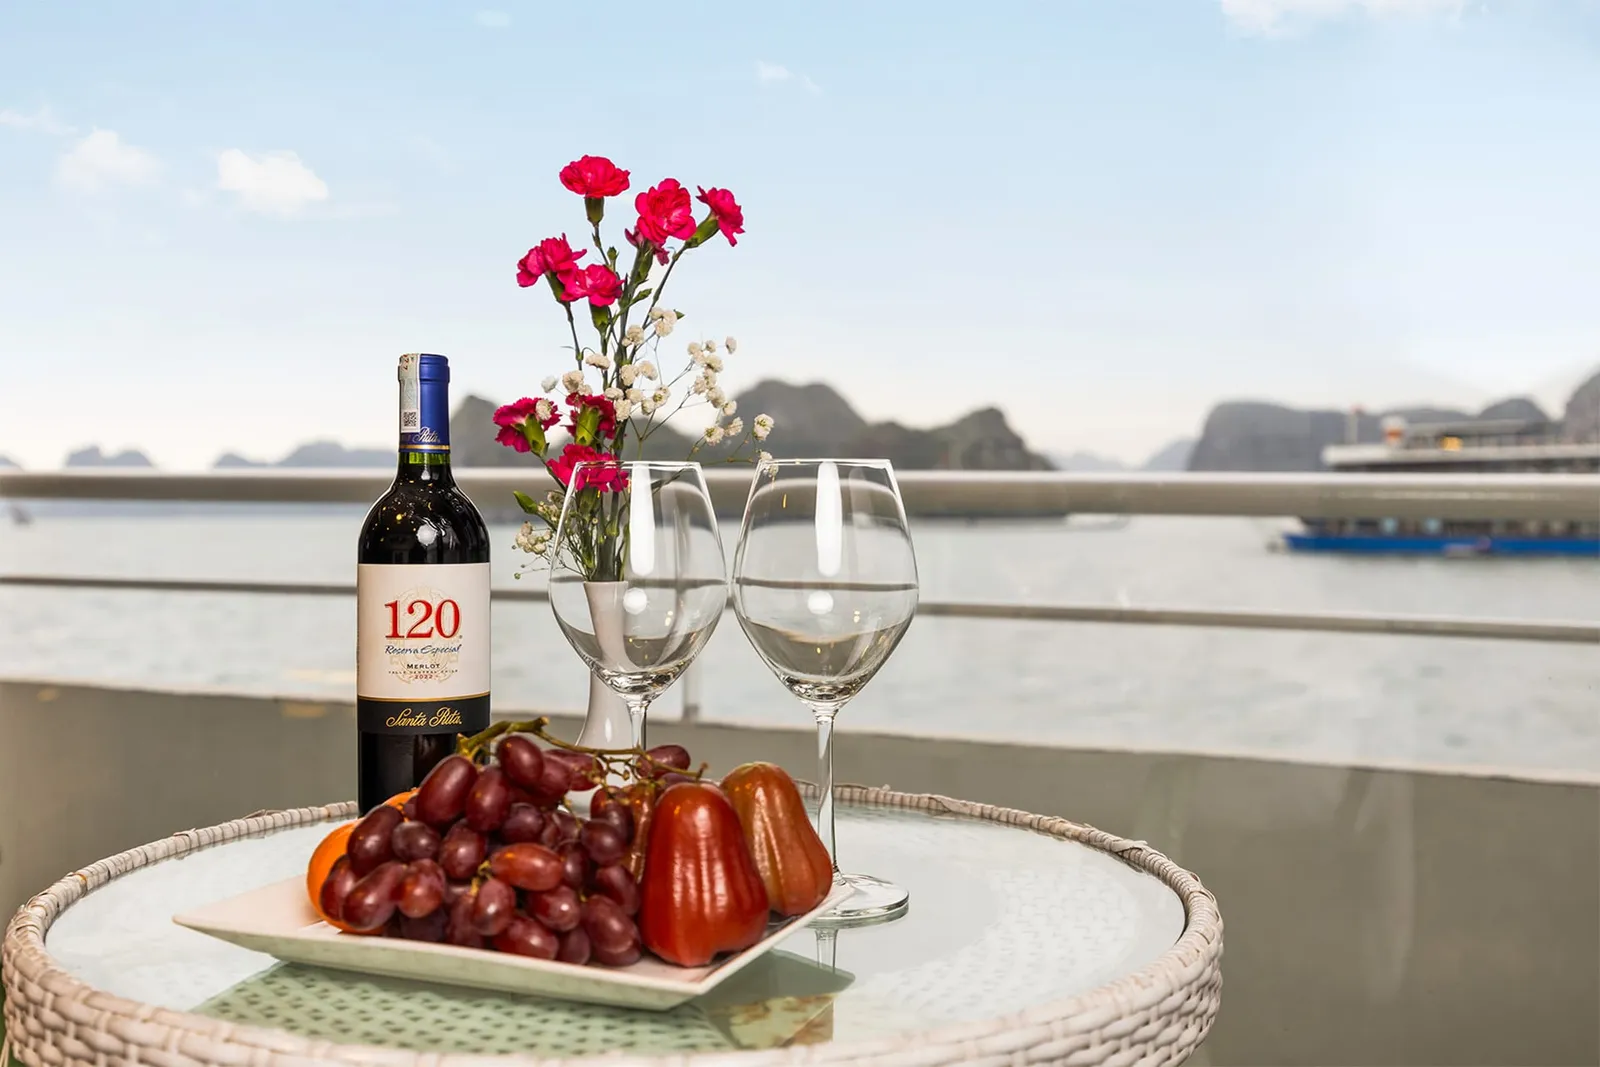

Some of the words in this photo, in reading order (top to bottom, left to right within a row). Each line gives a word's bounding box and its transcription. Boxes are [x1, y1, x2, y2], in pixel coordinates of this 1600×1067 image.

[385, 644, 419, 655] Reserva
[420, 644, 462, 657] Especial
[385, 708, 427, 727] Santa
